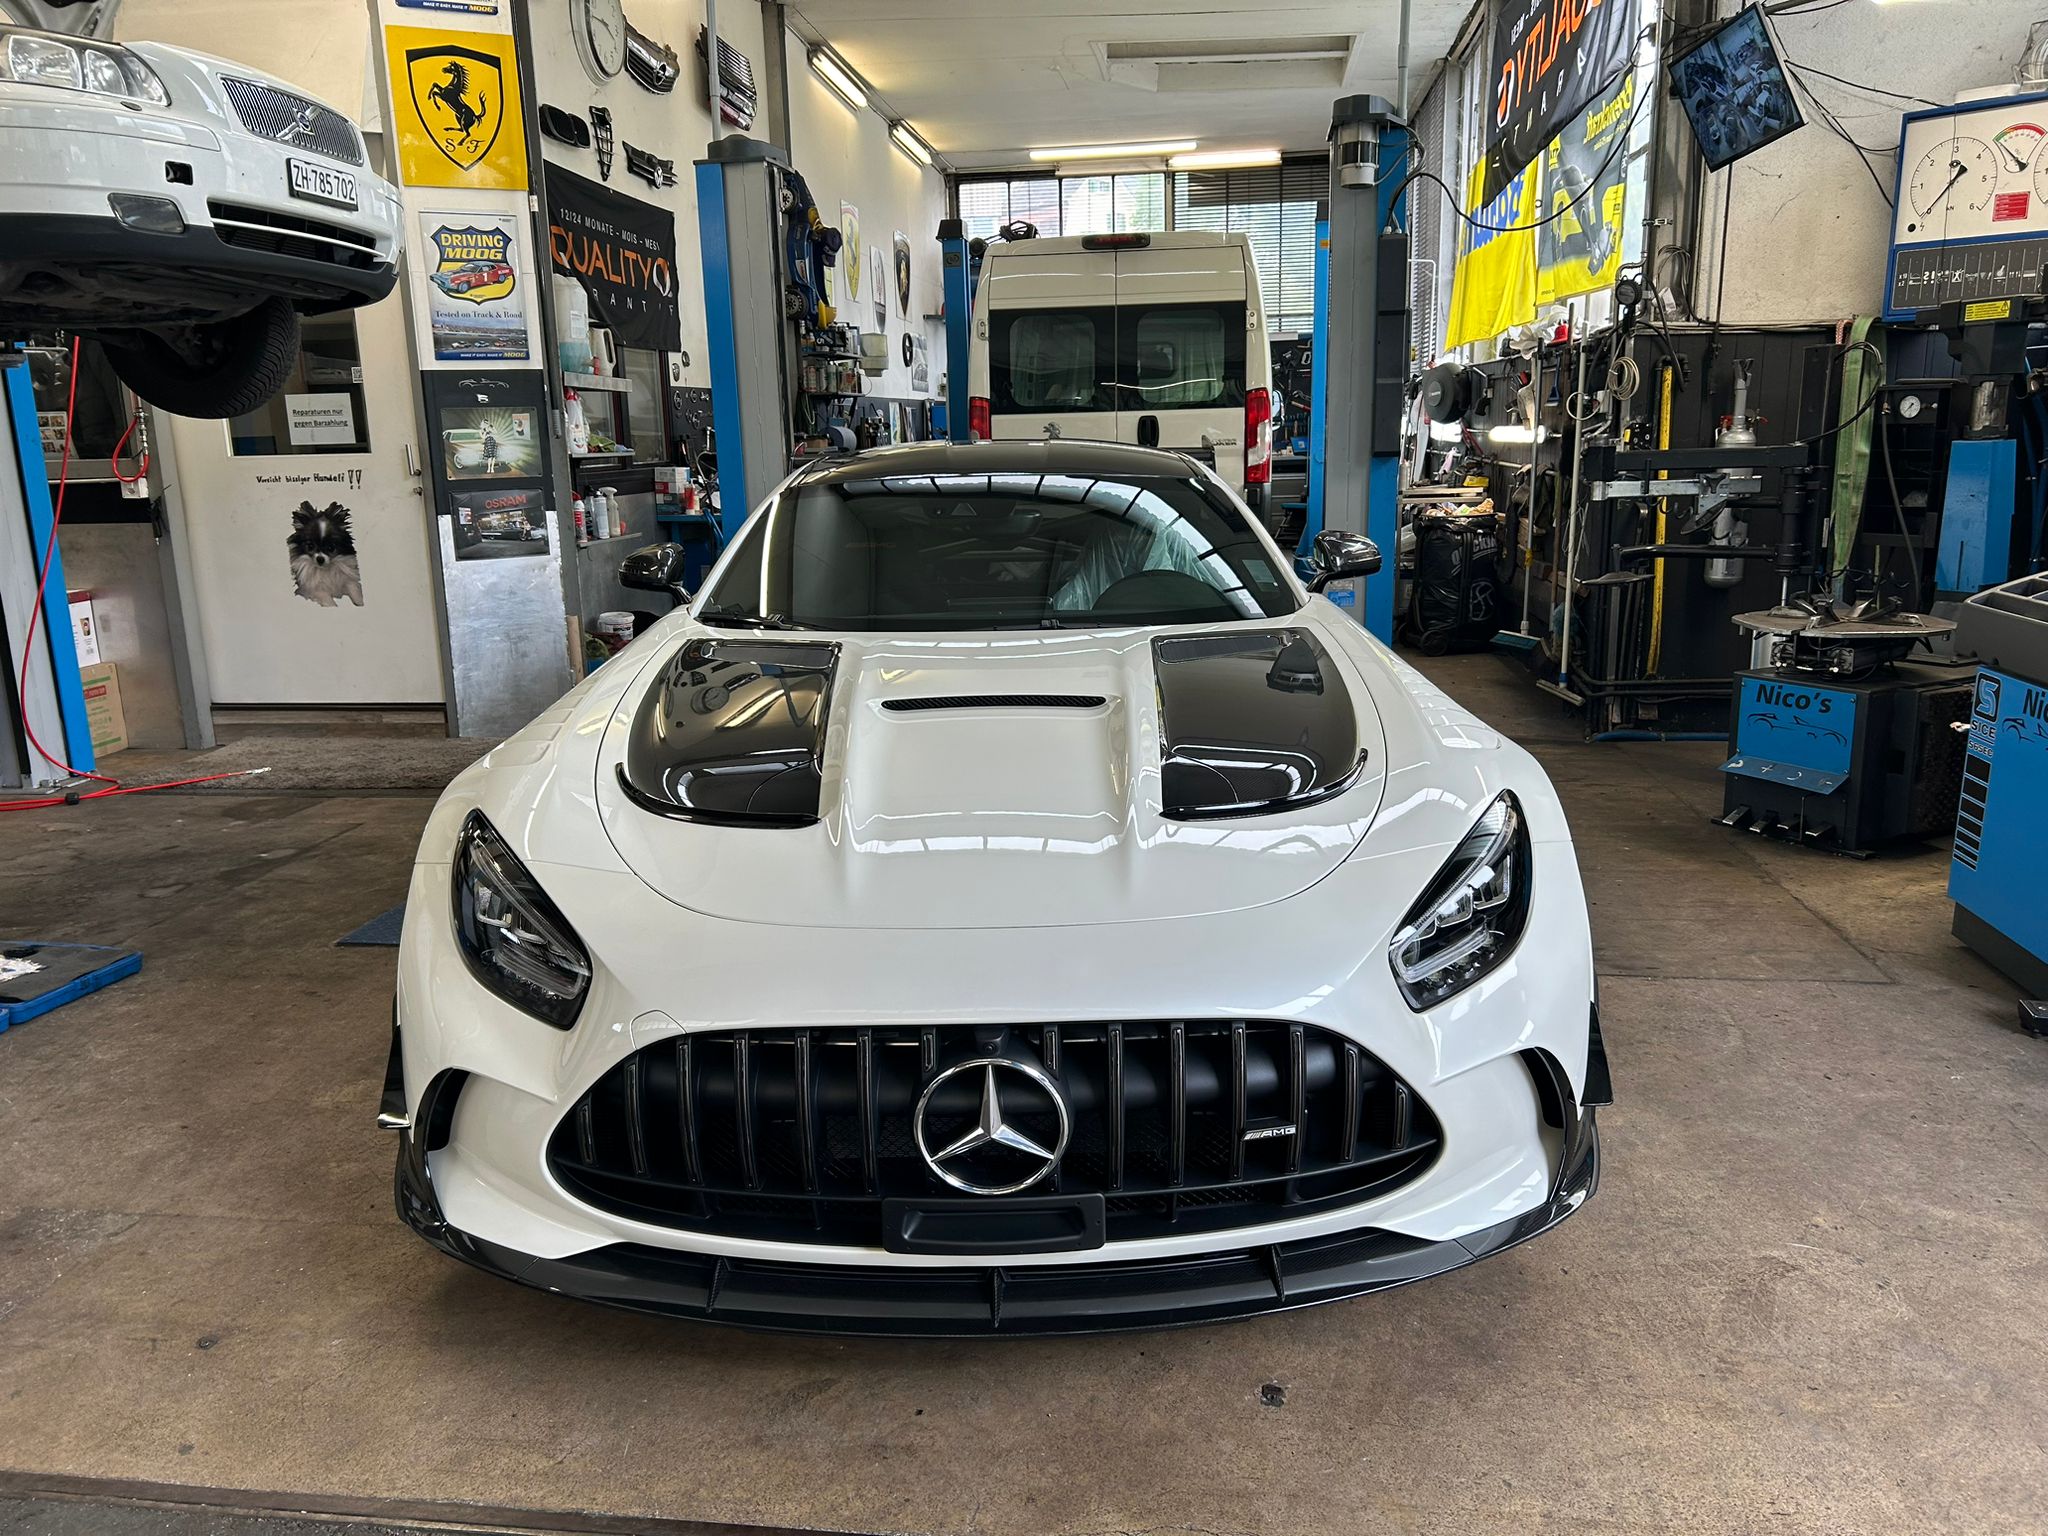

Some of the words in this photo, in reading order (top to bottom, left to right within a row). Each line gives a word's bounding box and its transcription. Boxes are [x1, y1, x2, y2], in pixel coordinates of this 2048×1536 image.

[585, 216, 614, 236] MONATE
[622, 230, 638, 244] MOIS
[441, 234, 504, 248] DRIVING
[444, 248, 504, 260] MOOG
[314, 420, 348, 428] Barzahlung
[256, 475, 282, 483] Vorsicht
[485, 494, 527, 509] OSRAM
[1756, 683, 1832, 714] Nico's
[1970, 719, 1997, 739] SICE
[1260, 1127, 1296, 1138] AMG
